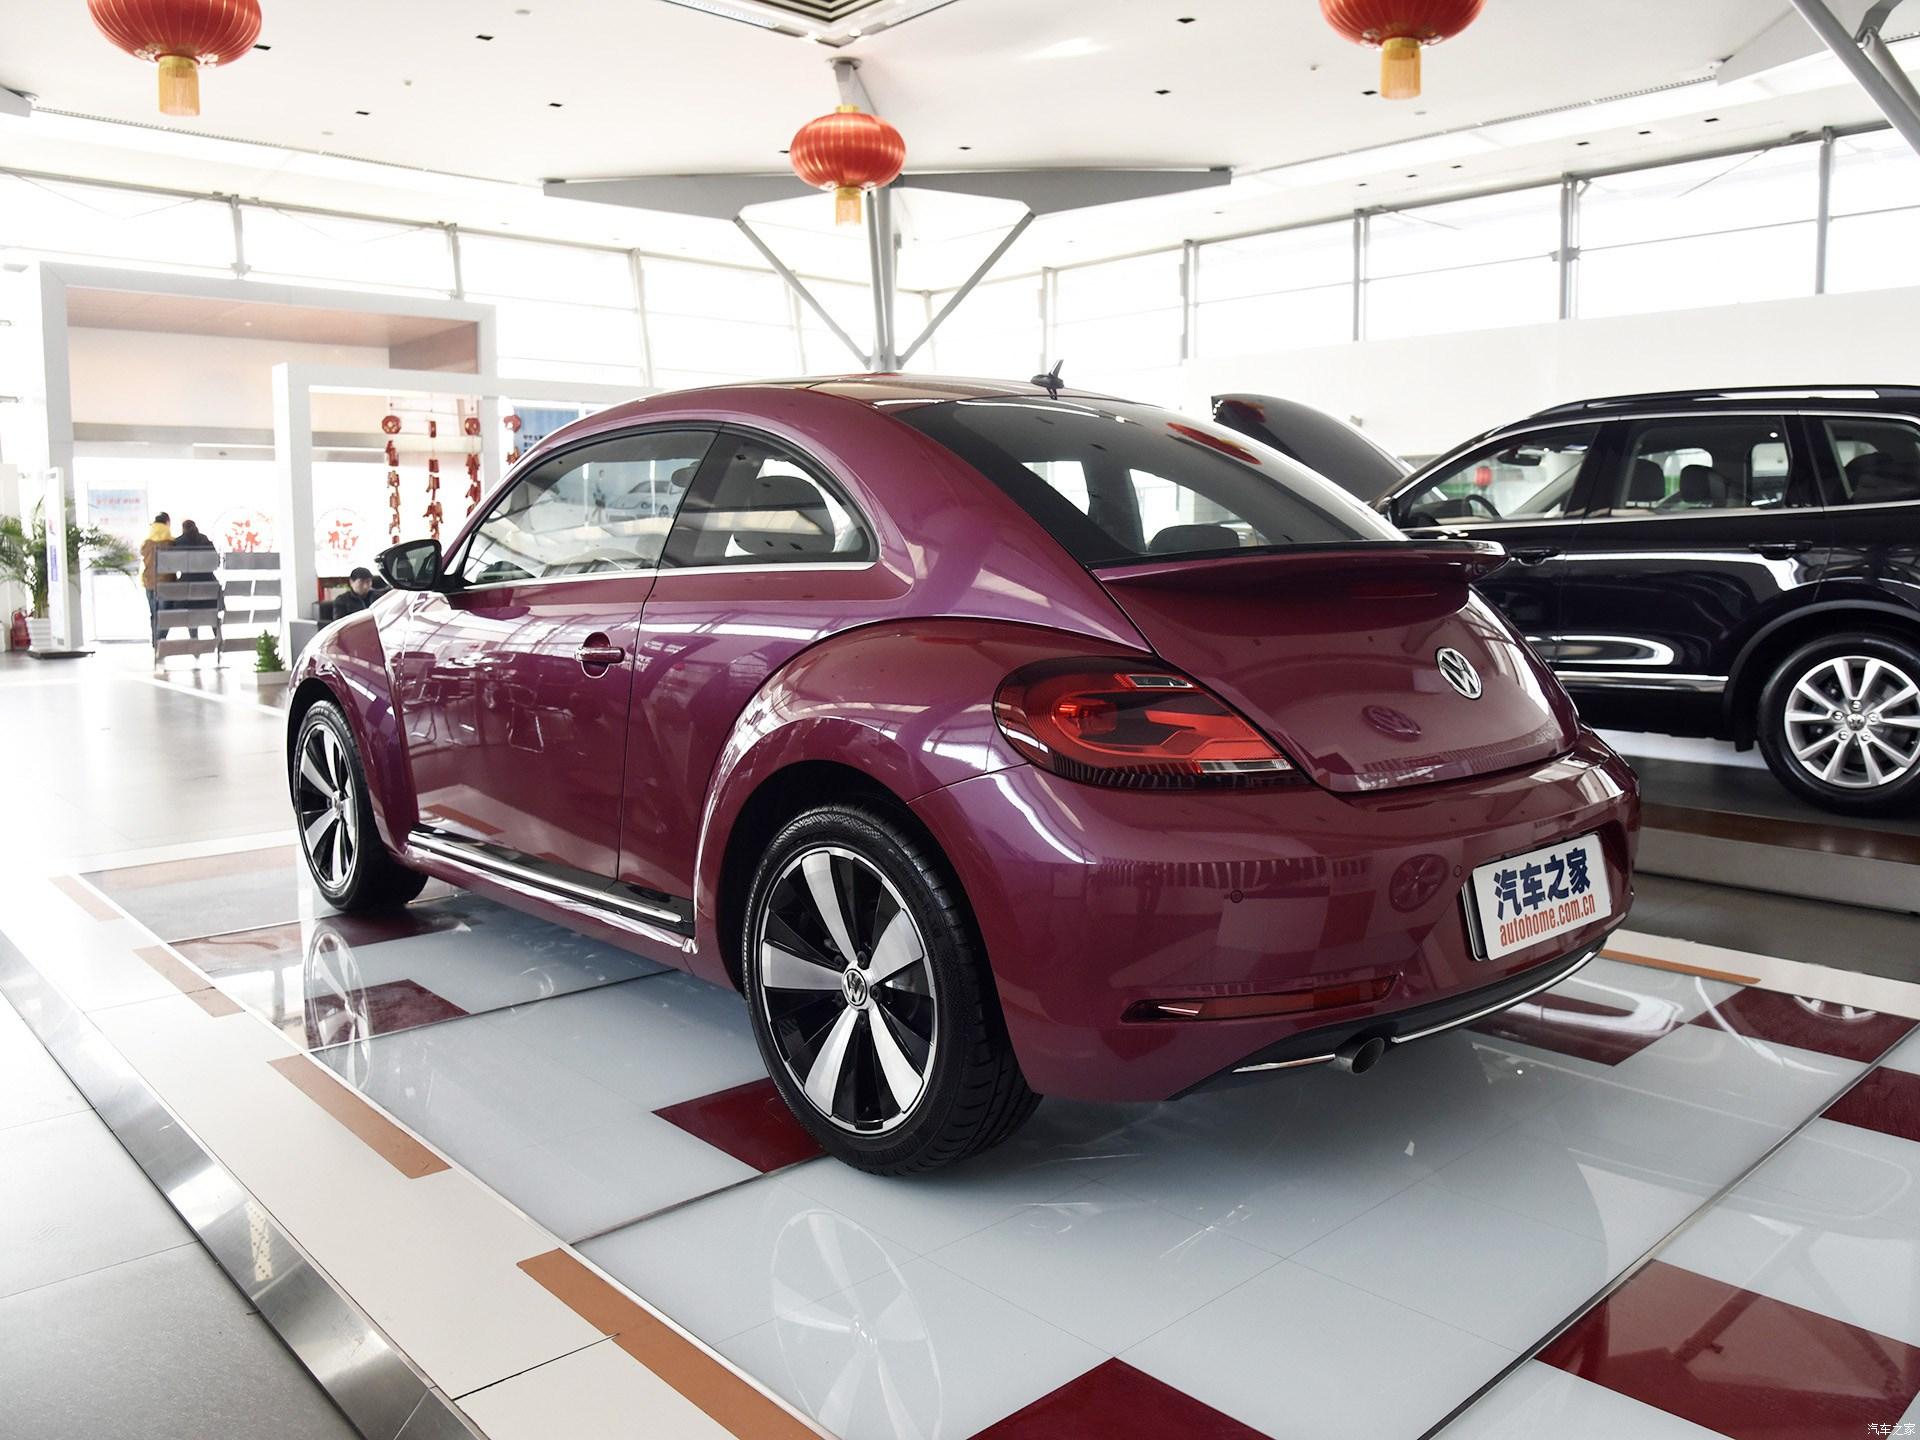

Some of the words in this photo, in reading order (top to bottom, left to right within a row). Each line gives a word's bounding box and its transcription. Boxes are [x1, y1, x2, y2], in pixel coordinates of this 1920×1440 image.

[1493, 847, 1590, 920] 汽车之家
[1500, 893, 1596, 947] autohome.com.cn
